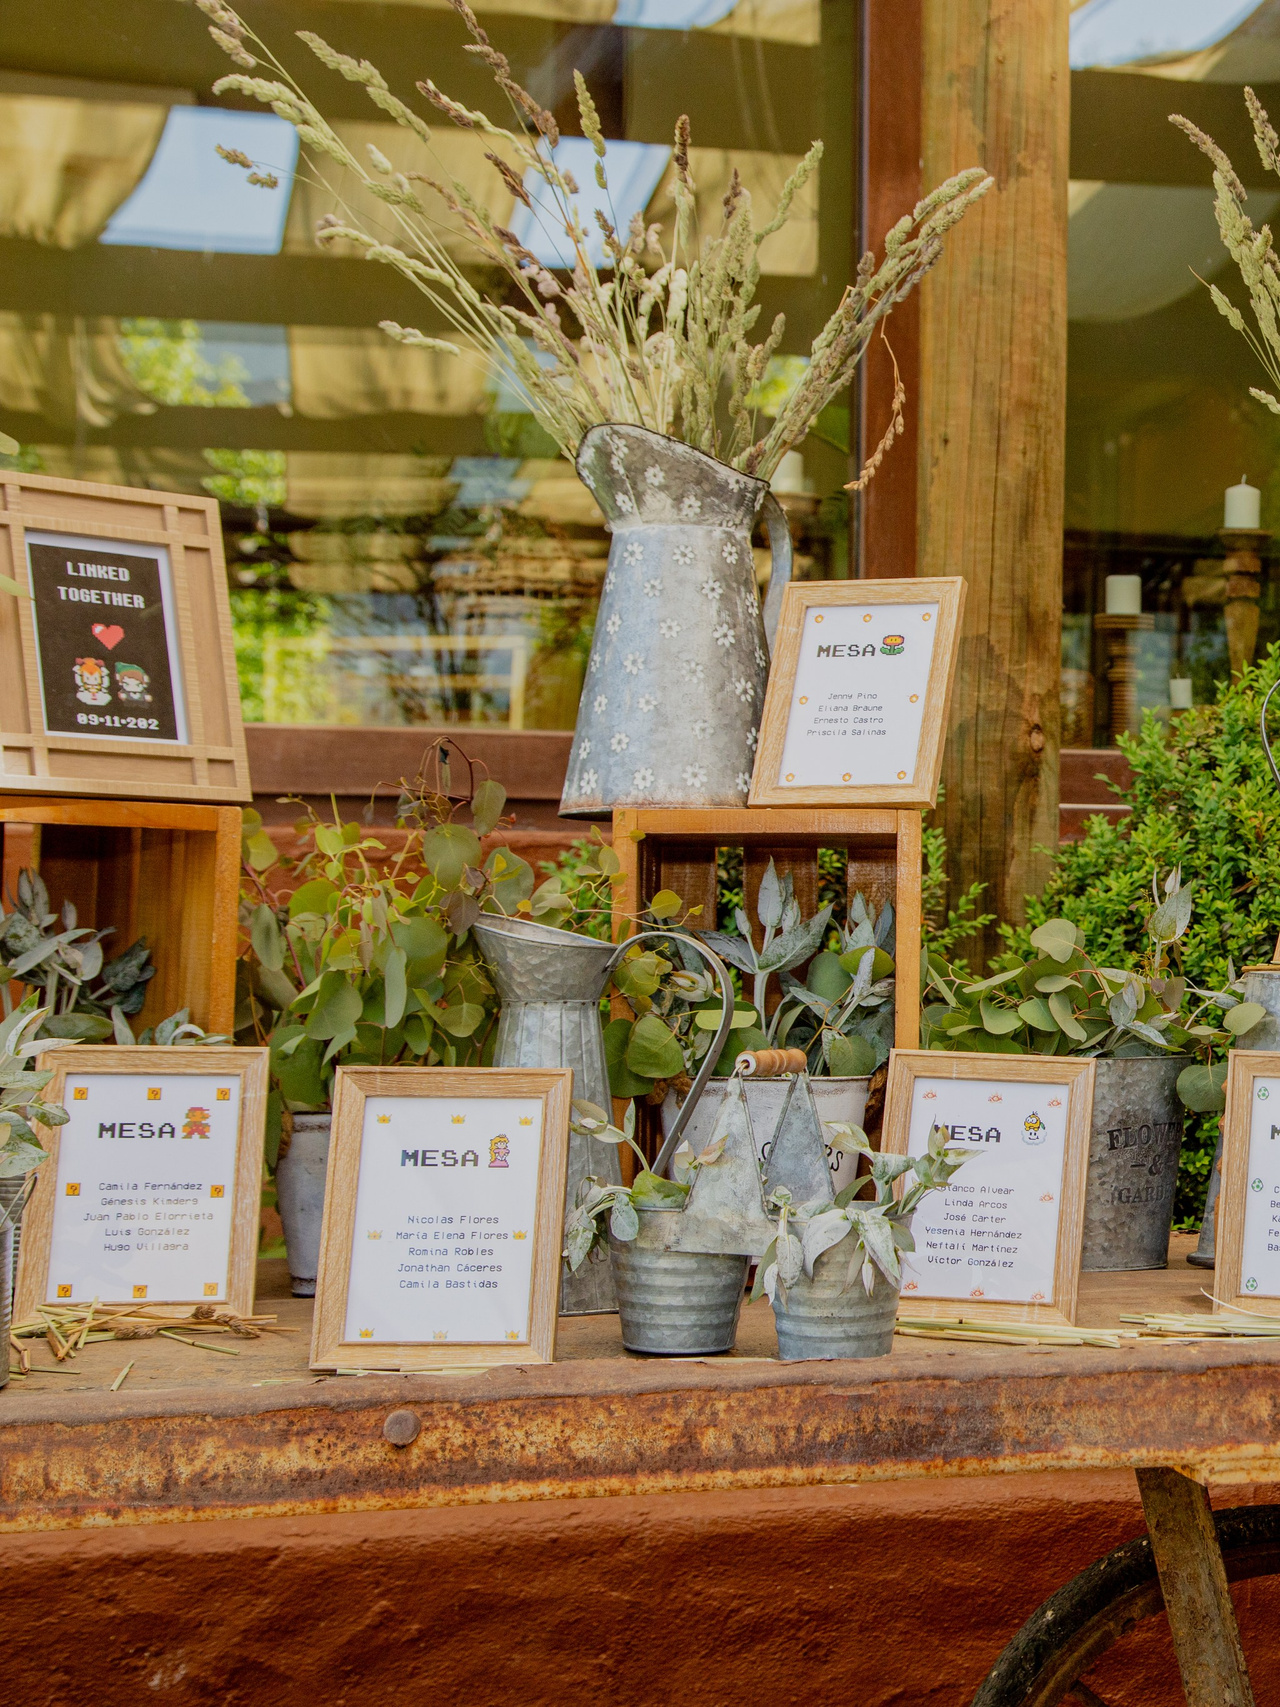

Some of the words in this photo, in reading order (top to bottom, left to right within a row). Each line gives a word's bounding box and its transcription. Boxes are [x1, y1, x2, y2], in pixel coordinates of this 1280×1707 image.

[66, 561, 130, 582] LINKED
[57, 586, 145, 609] TOGETHER
[816, 644, 876, 657] MESA
[98, 1122, 176, 1139] MESA
[400, 1150, 479, 1167] MESA
[98, 1183, 138, 1191] Camila
[144, 1182, 203, 1190] Fernández
[980, 1186, 1015, 1195] Alvear
[101, 1197, 146, 1206] Génesis
[944, 1199, 974, 1207] Linda
[979, 1201, 1008, 1209] Arcos
[83, 1213, 110, 1221] Juan
[115, 1212, 149, 1221] Pablo
[155, 1212, 214, 1220] Elorrieta
[407, 1215, 454, 1224] Nicolas
[459, 1215, 499, 1224] Flores
[943, 1213, 966, 1222] José
[972, 1214, 1007, 1224] Carter
[105, 1228, 131, 1236] Luis
[137, 1227, 190, 1236] González
[396, 1231, 428, 1240] María
[433, 1231, 465, 1240] Elena
[471, 1231, 509, 1240] Flores
[925, 1226, 965, 1236] Yesenia
[970, 1229, 1022, 1239] Hernández
[103, 1243, 130, 1251] Hugo
[136, 1243, 189, 1251] Villagra
[408, 1247, 448, 1256] Romina
[454, 1247, 494, 1256] Robles
[926, 1241, 966, 1250] Neftalí
[972, 1244, 1018, 1254] Martínez
[928, 1255, 962, 1265] Víctor
[967, 1258, 1014, 1268] González
[398, 1264, 450, 1272] Jonathan
[456, 1263, 503, 1272] Cáceres
[399, 1280, 439, 1288] Camila
[445, 1280, 498, 1288] Bastidas
